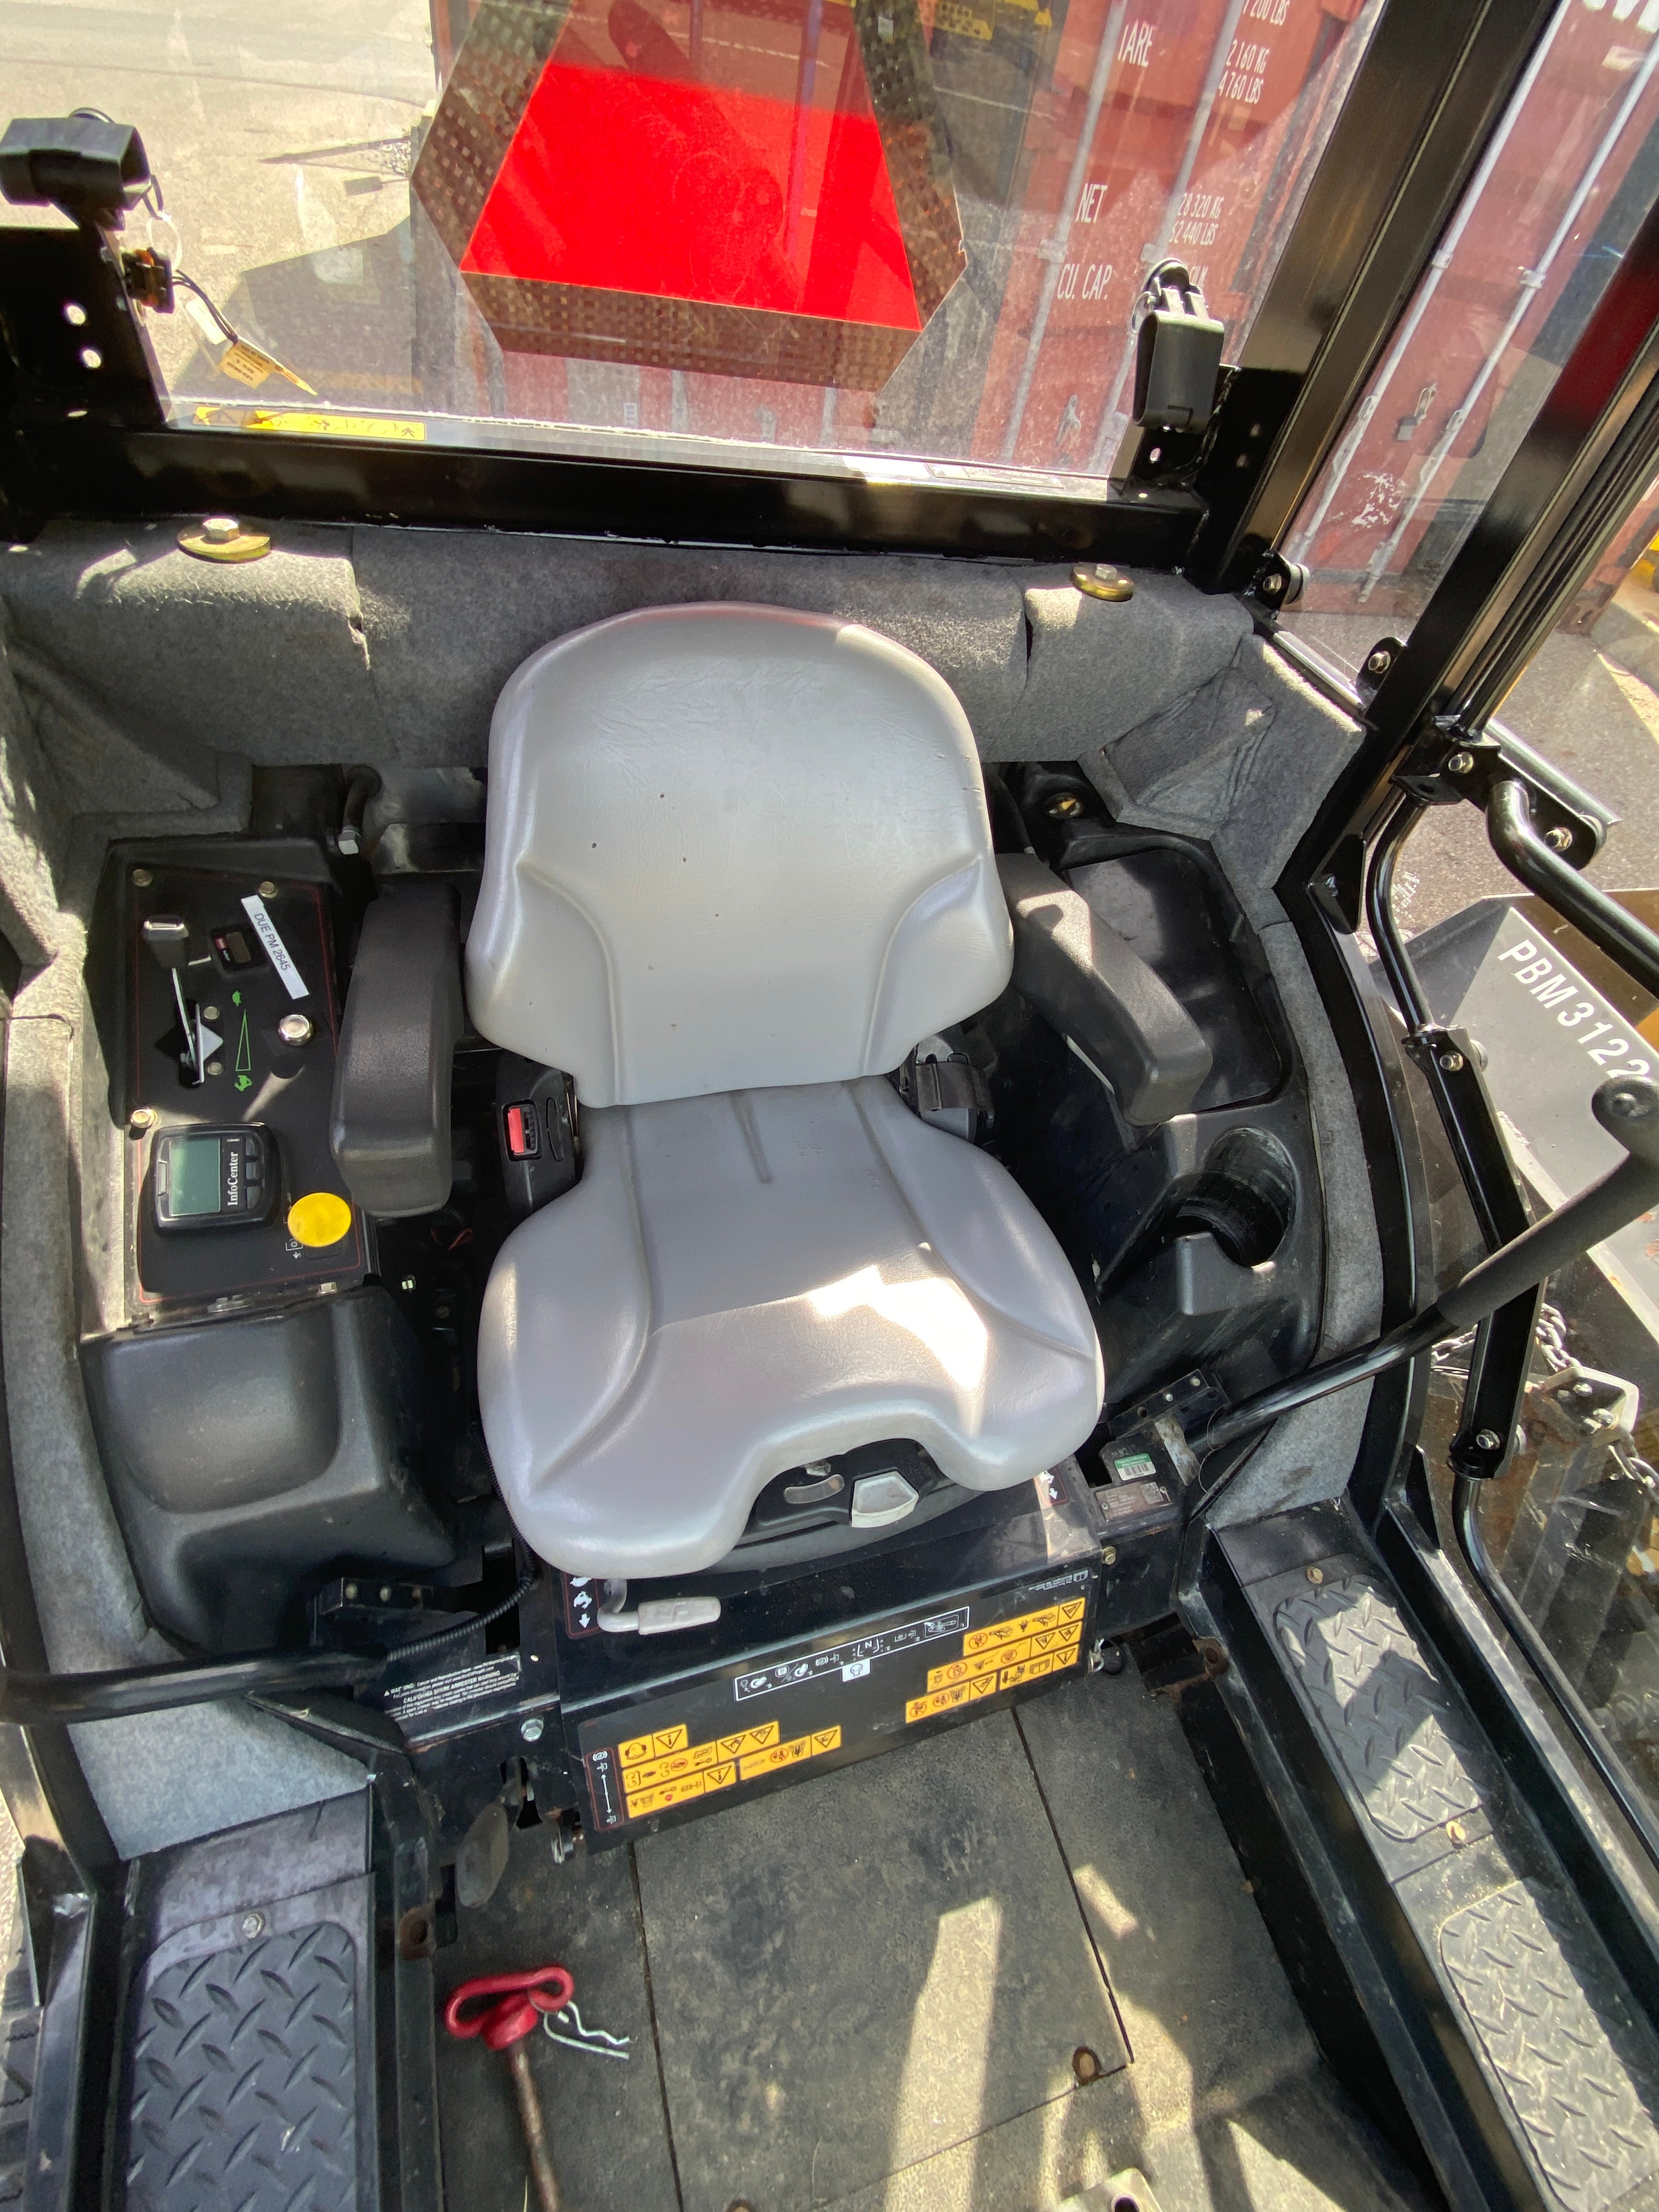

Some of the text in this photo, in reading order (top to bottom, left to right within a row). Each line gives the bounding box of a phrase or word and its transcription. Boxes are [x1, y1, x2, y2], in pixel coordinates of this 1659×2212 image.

[1270, 0, 1290, 26] LBS
[1235, 41, 1257, 71] 160
[1254, 46, 1270, 74] KG
[1226, 71, 1247, 100] 760
[1244, 76, 1264, 105] LBS
[1076, 183, 1108, 223] NET
[1200, 223, 1219, 245] LBS
[1057, 263, 1113, 300] CU. CAP.
[254, 913, 291, 970] DUE PM 2645
[227, 1152, 238, 1206] InfoCenter
